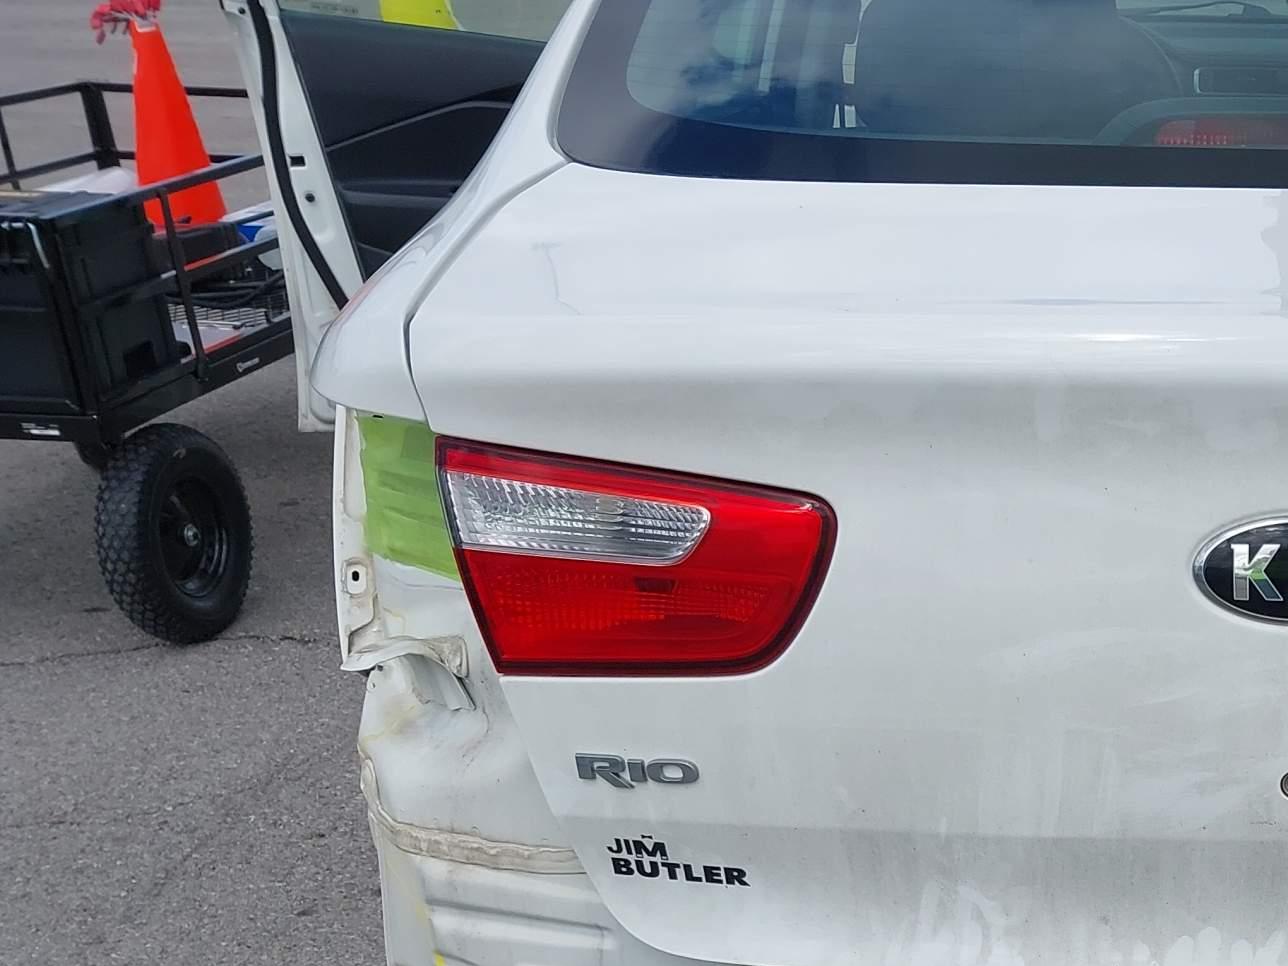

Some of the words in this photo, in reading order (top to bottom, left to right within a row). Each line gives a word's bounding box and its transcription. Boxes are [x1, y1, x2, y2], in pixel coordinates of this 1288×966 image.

[575, 752, 700, 789] RIO
[606, 837, 669, 860] JIM
[611, 857, 751, 887] BUTLER
